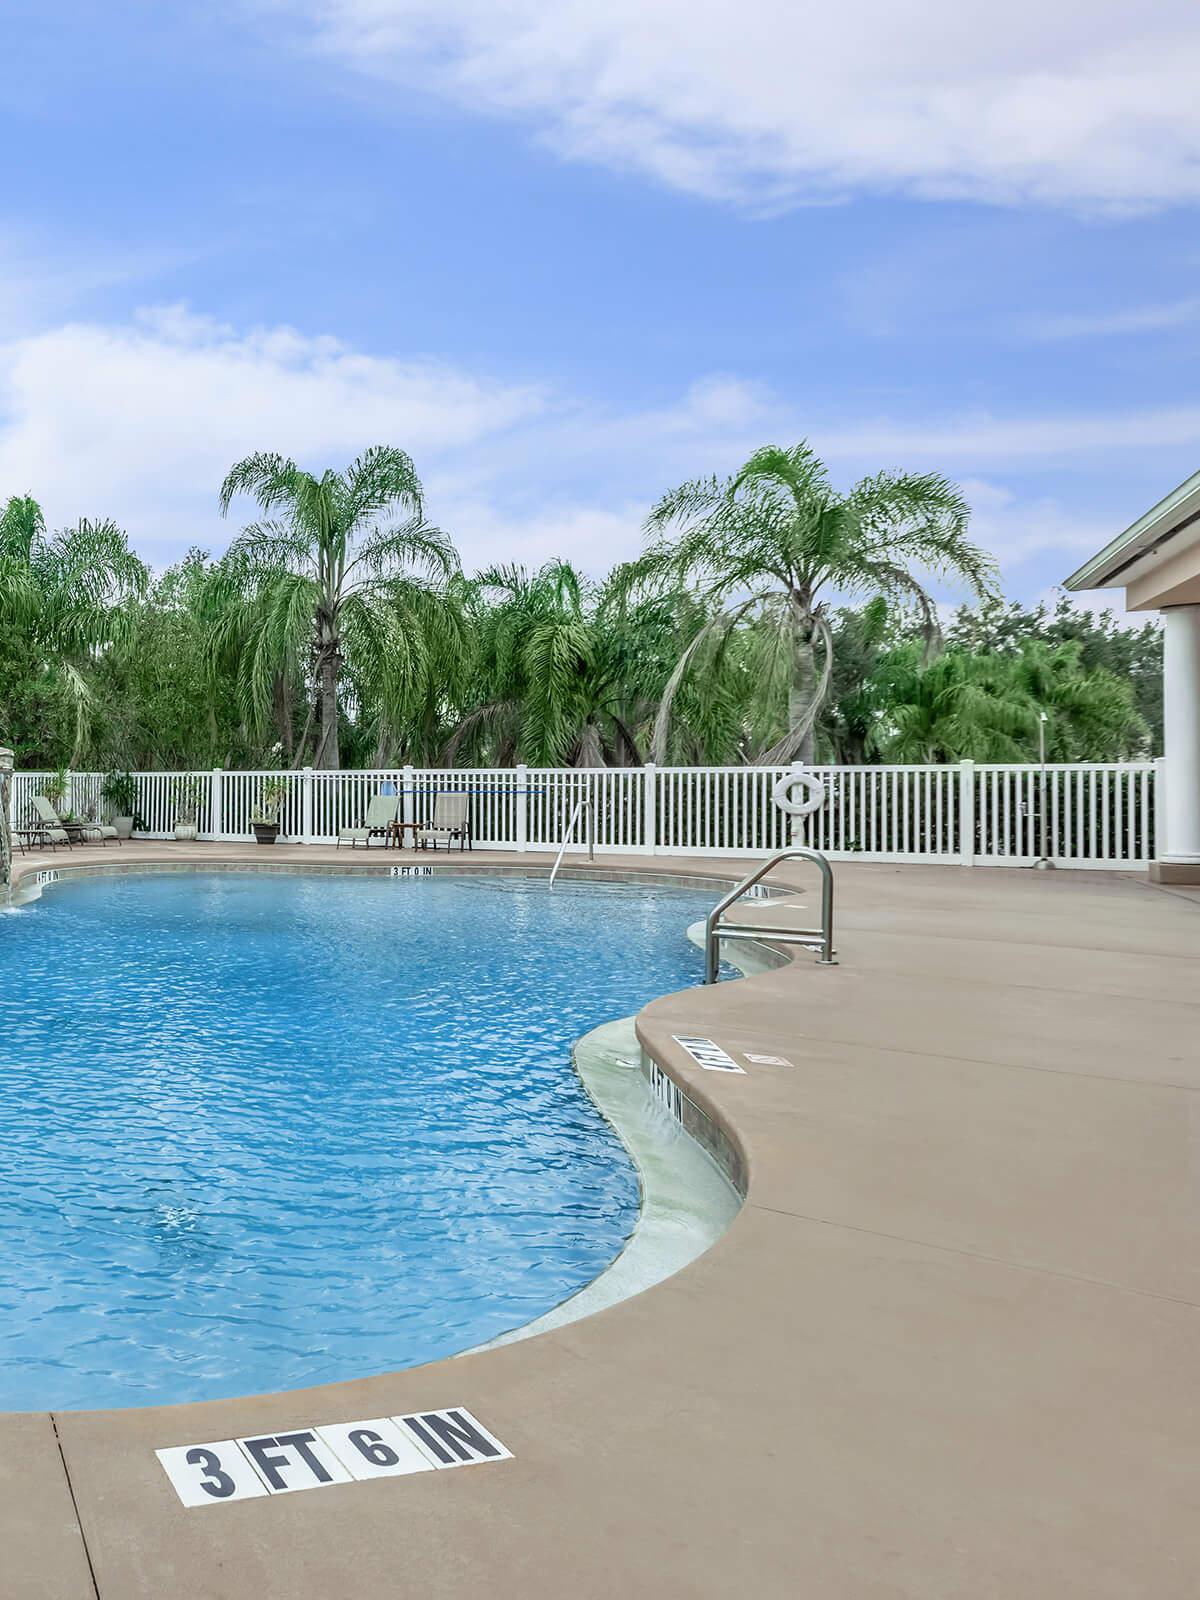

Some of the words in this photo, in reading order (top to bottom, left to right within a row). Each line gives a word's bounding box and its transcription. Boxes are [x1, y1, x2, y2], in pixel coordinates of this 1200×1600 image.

[401, 867, 411, 875] FT
[423, 867, 432, 875] IN
[186, 1448, 237, 1498] 3
[243, 1431, 334, 1490] FT
[347, 1429, 400, 1467] 6
[402, 1411, 502, 1465] IN
